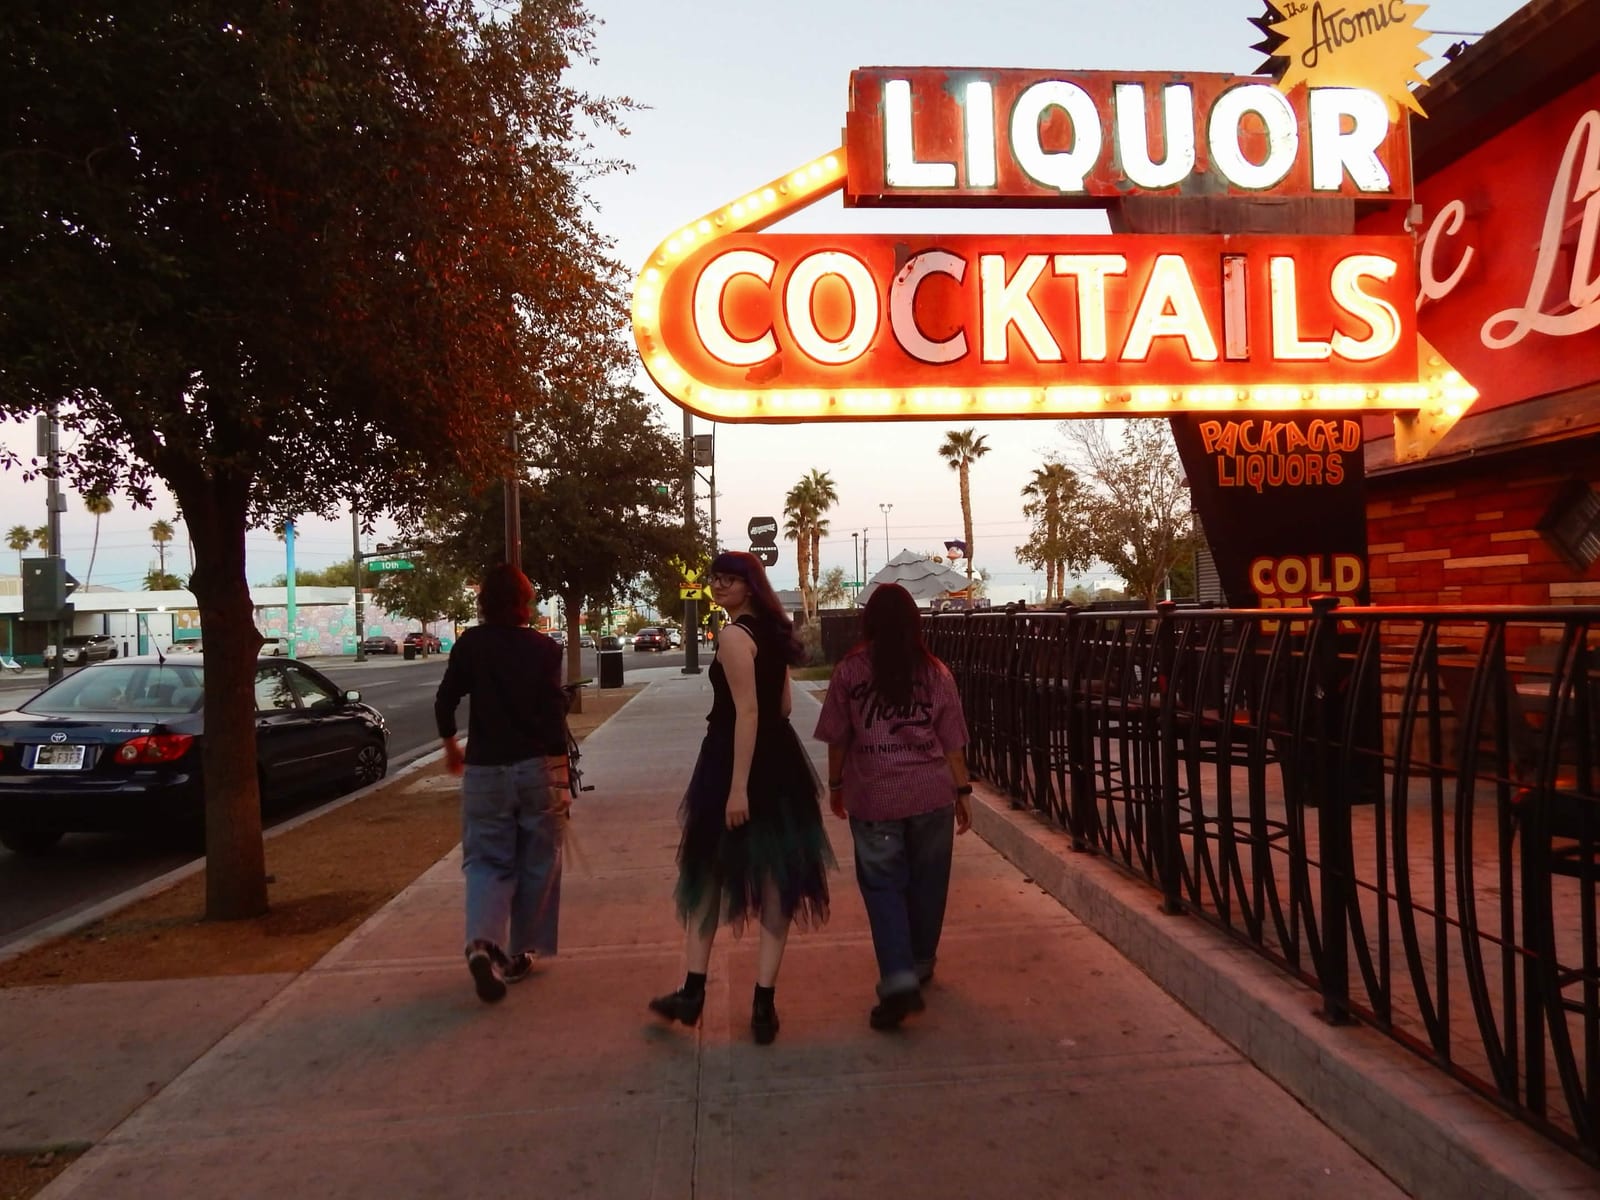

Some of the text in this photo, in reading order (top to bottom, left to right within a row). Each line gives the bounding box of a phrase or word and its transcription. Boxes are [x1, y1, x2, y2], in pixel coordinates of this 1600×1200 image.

[1283, 2, 1308, 18] The
[1302, 0, 1406, 68] Atomic
[884, 79, 1391, 192] LIQUOR
[692, 248, 1402, 366] COCKTAILS
[1199, 419, 1360, 458] PACKAGED
[1217, 454, 1344, 493] LIQUORS
[1251, 556, 1362, 595] COLD
[1260, 597, 1358, 632] BER
